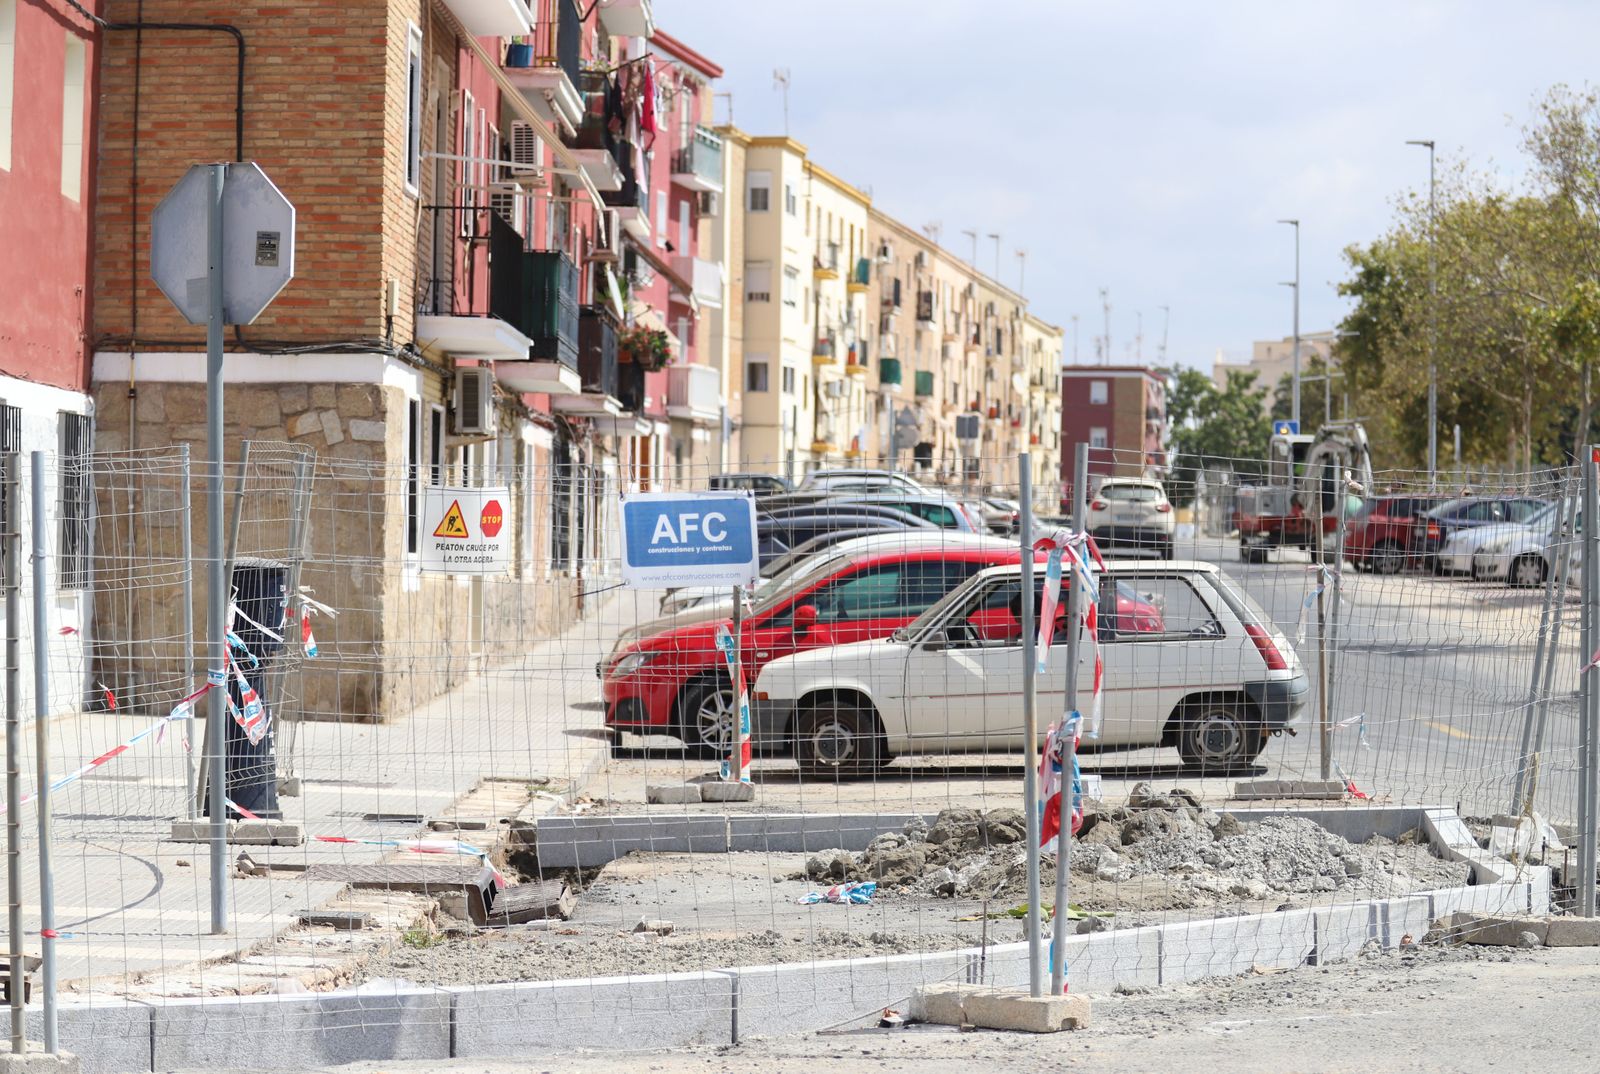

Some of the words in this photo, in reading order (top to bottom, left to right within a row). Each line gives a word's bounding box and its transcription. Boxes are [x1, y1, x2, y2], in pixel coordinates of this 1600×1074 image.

[482, 516, 502, 524] STOP
[651, 512, 728, 545] AFC
[436, 543, 465, 551] PEATON
[466, 544, 486, 552] CRUCE
[488, 544, 499, 552] POR
[443, 555, 452, 563] LA
[641, 572, 741, 582] www.afcconstrucciones.com
